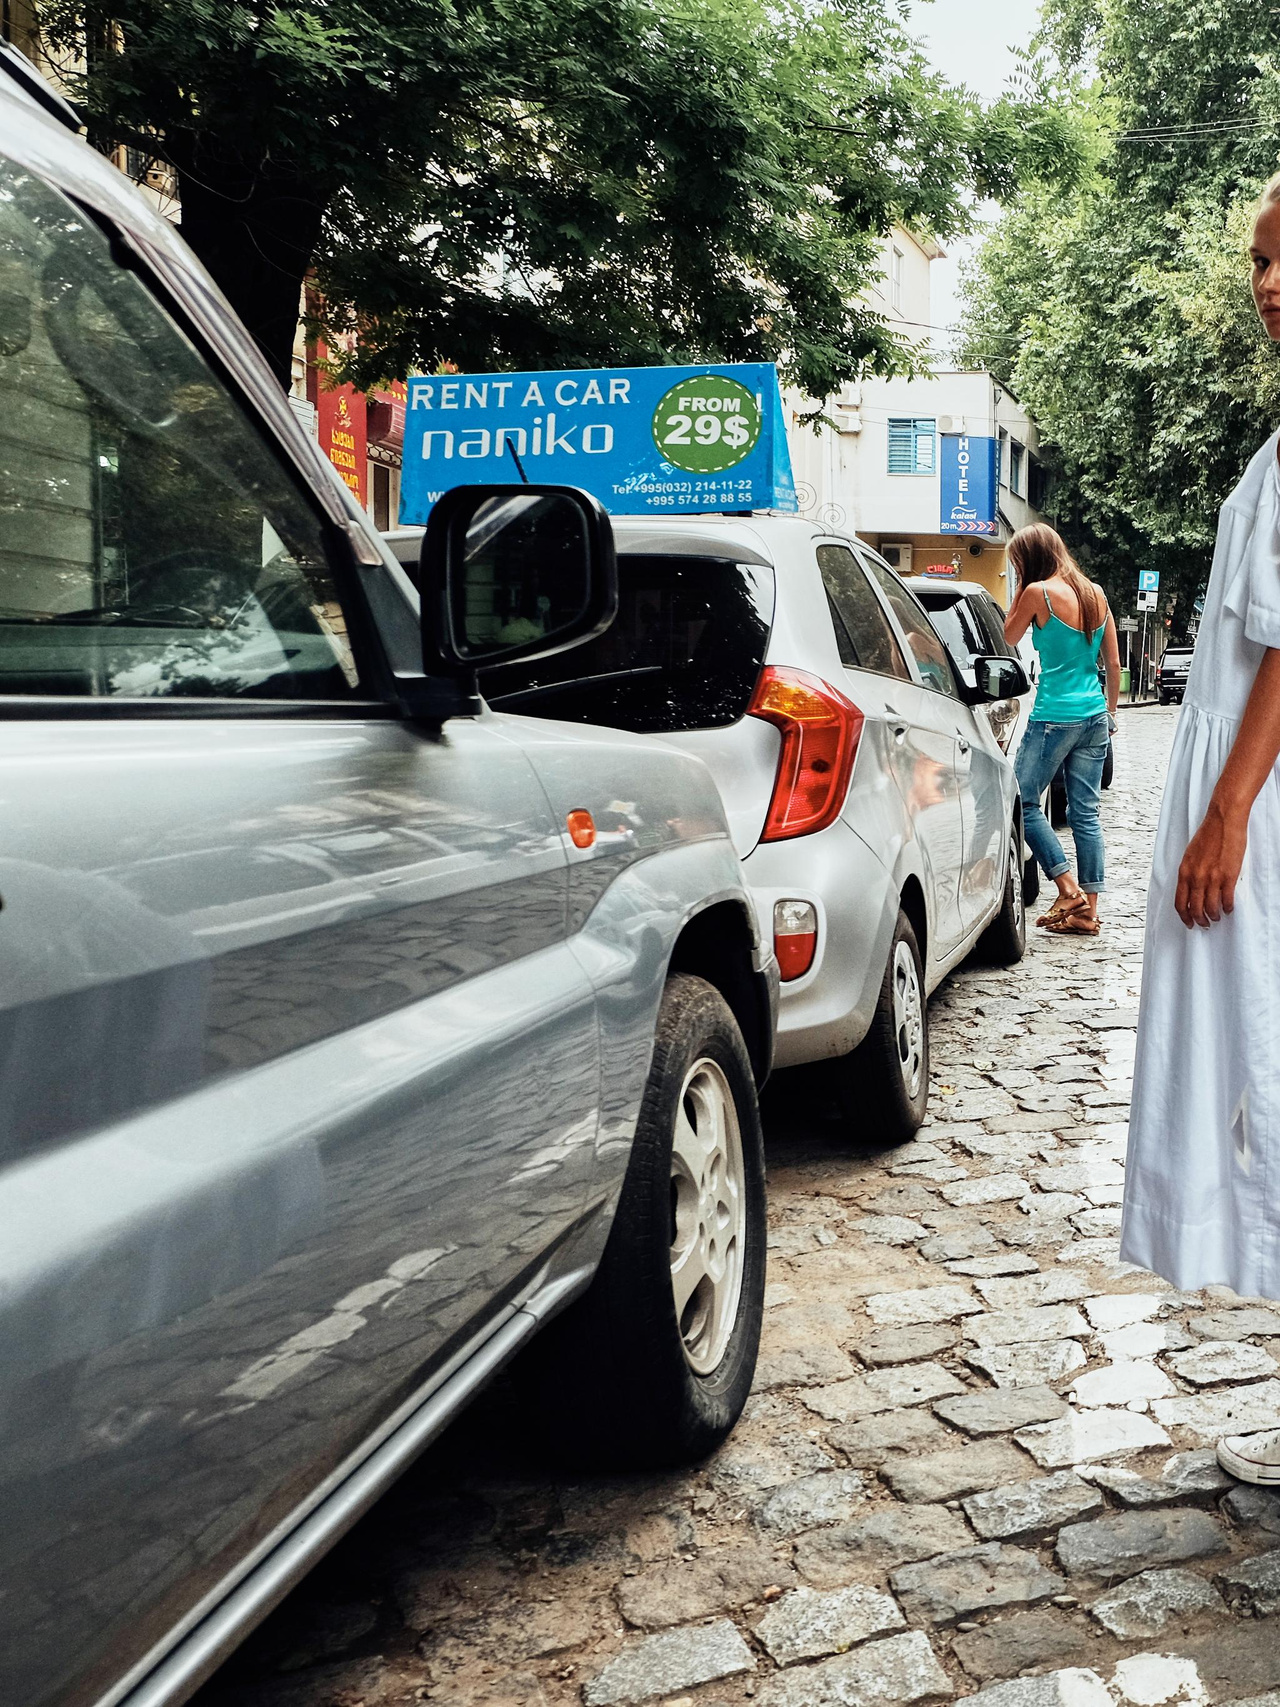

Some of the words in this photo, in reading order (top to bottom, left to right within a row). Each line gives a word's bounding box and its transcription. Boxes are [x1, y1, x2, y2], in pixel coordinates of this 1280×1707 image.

[411, 381, 513, 410] RENT
[521, 381, 545, 407] A
[555, 378, 631, 406] CAR
[678, 397, 741, 412] FROM
[421, 413, 614, 460] naniko
[663, 414, 750, 449] 29$
[957, 437, 970, 506] HOTEL
[695, 479, 752, 491] 214-11-22
[645, 495, 675, 506] +995
[678, 494, 700, 505] 574
[702, 493, 717, 504] 28
[720, 493, 734, 503] 88
[738, 492, 752, 503] 55
[941, 522, 950, 530] 20
[1143, 572, 1156, 589] P
